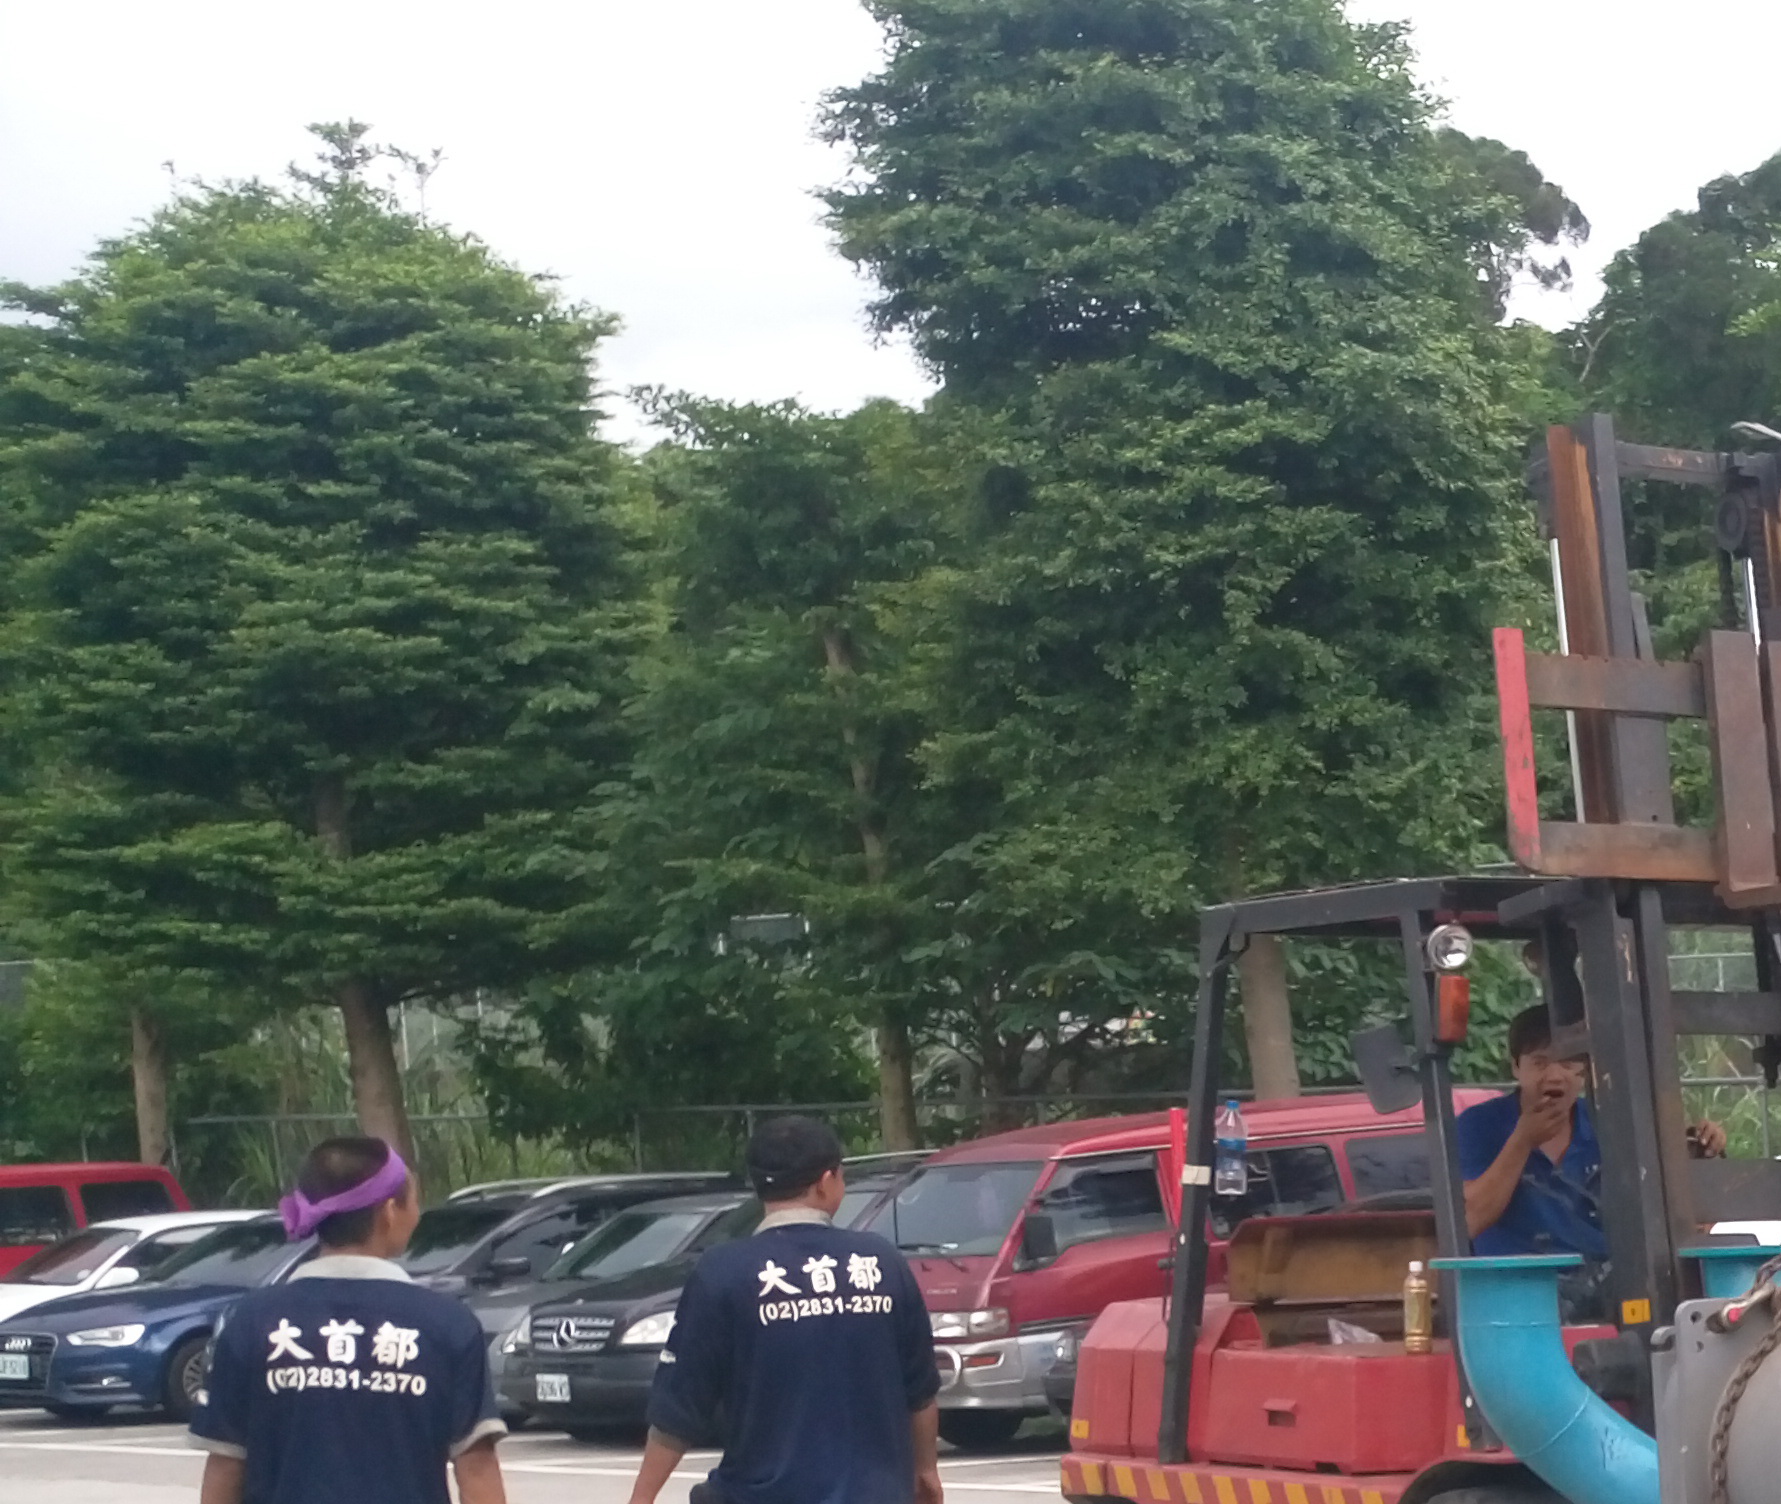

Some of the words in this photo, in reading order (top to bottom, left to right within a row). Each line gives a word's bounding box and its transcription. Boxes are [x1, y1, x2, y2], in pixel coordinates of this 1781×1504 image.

[757, 1252, 883, 1297] 大首都
[758, 1295, 893, 1326] (02)2831-2370
[266, 1317, 421, 1369] 大首都
[266, 1365, 427, 1396] (02)2831-2370
